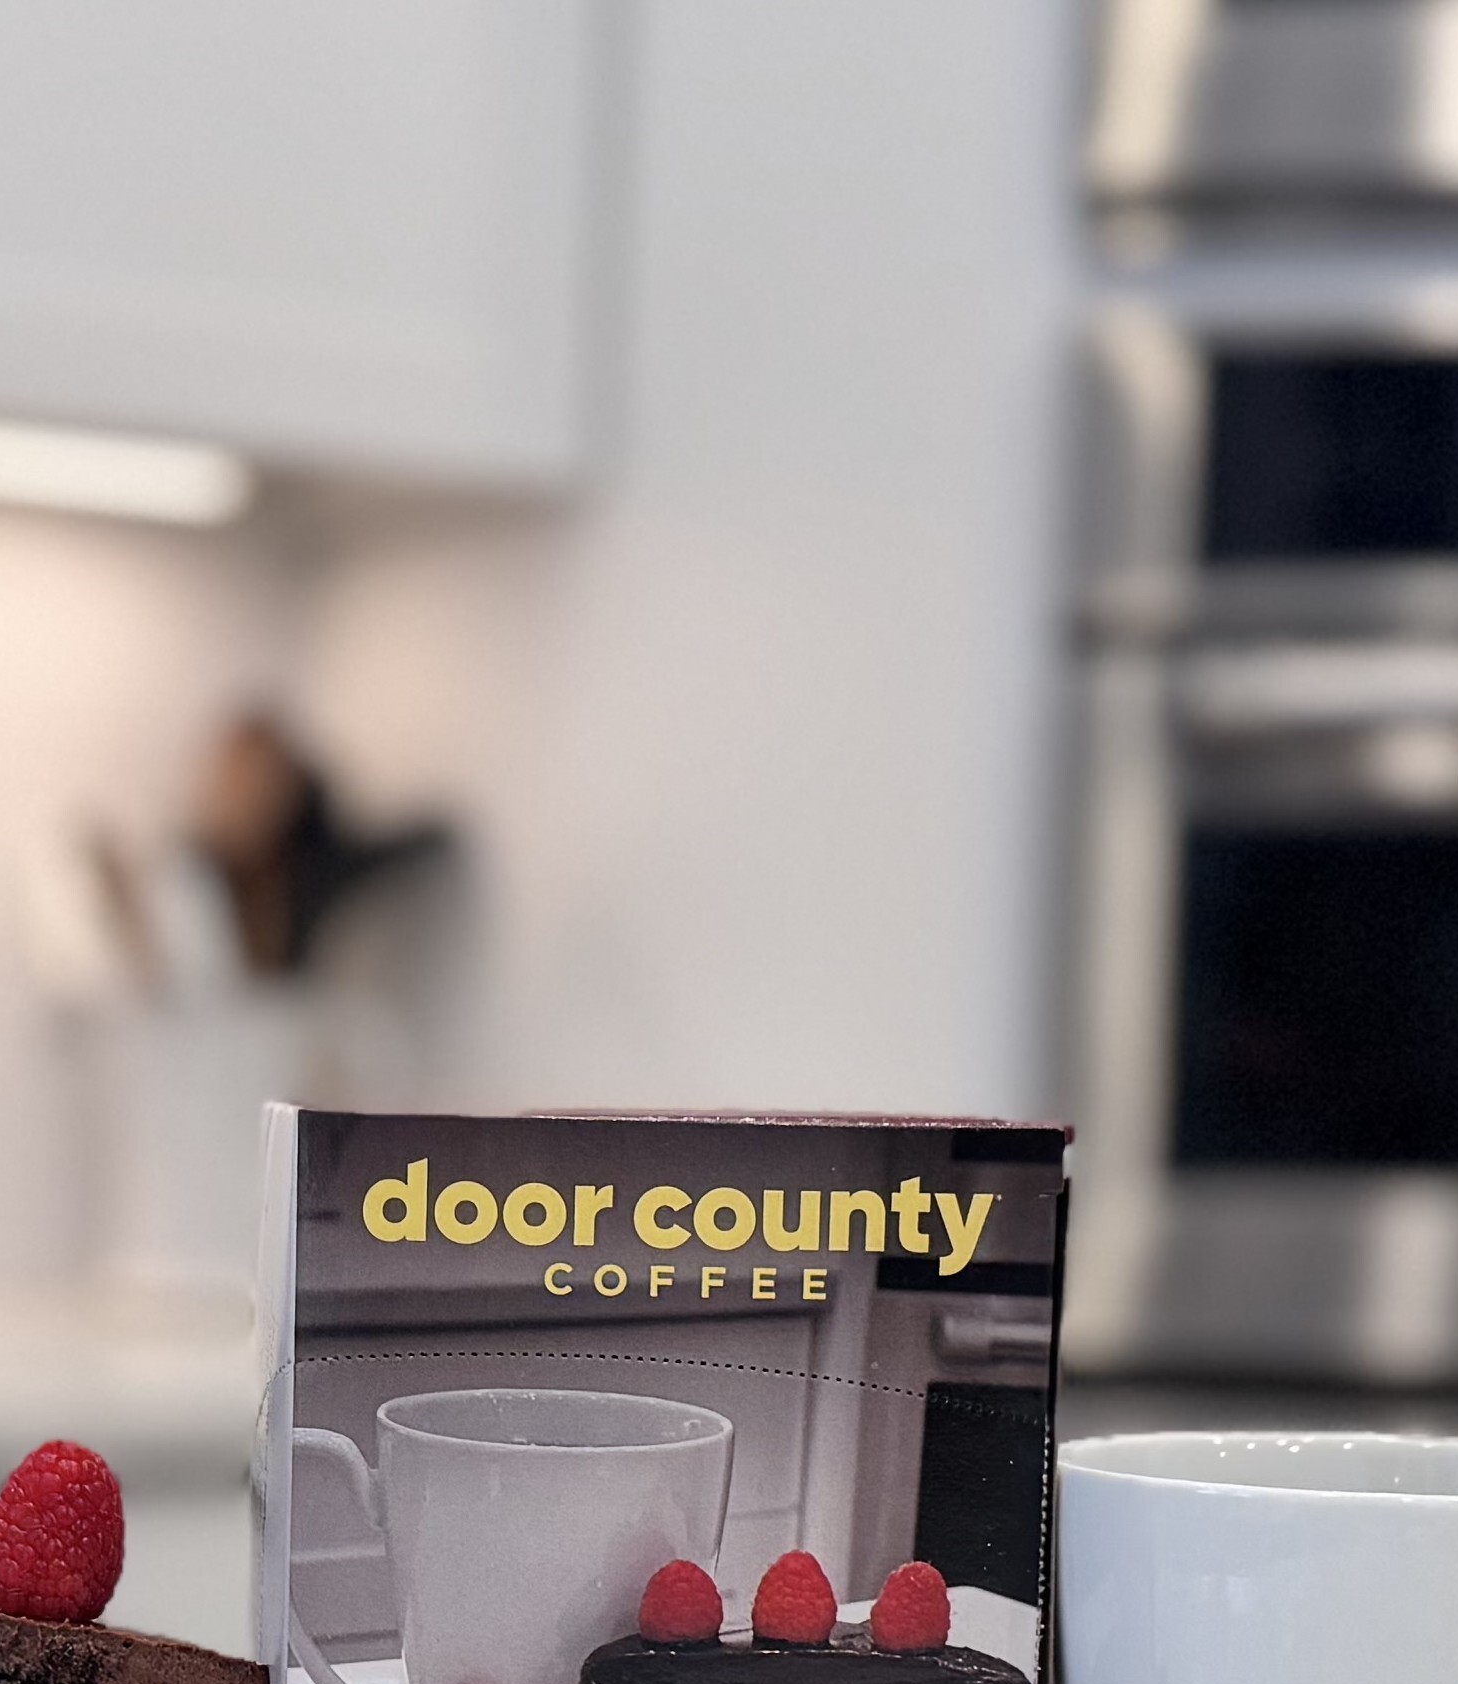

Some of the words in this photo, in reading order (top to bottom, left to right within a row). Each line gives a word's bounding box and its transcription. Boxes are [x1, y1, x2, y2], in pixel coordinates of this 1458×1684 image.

[362, 1157, 614, 1246] door
[633, 1176, 994, 1277] county
[544, 1261, 829, 1301] COFFEE
